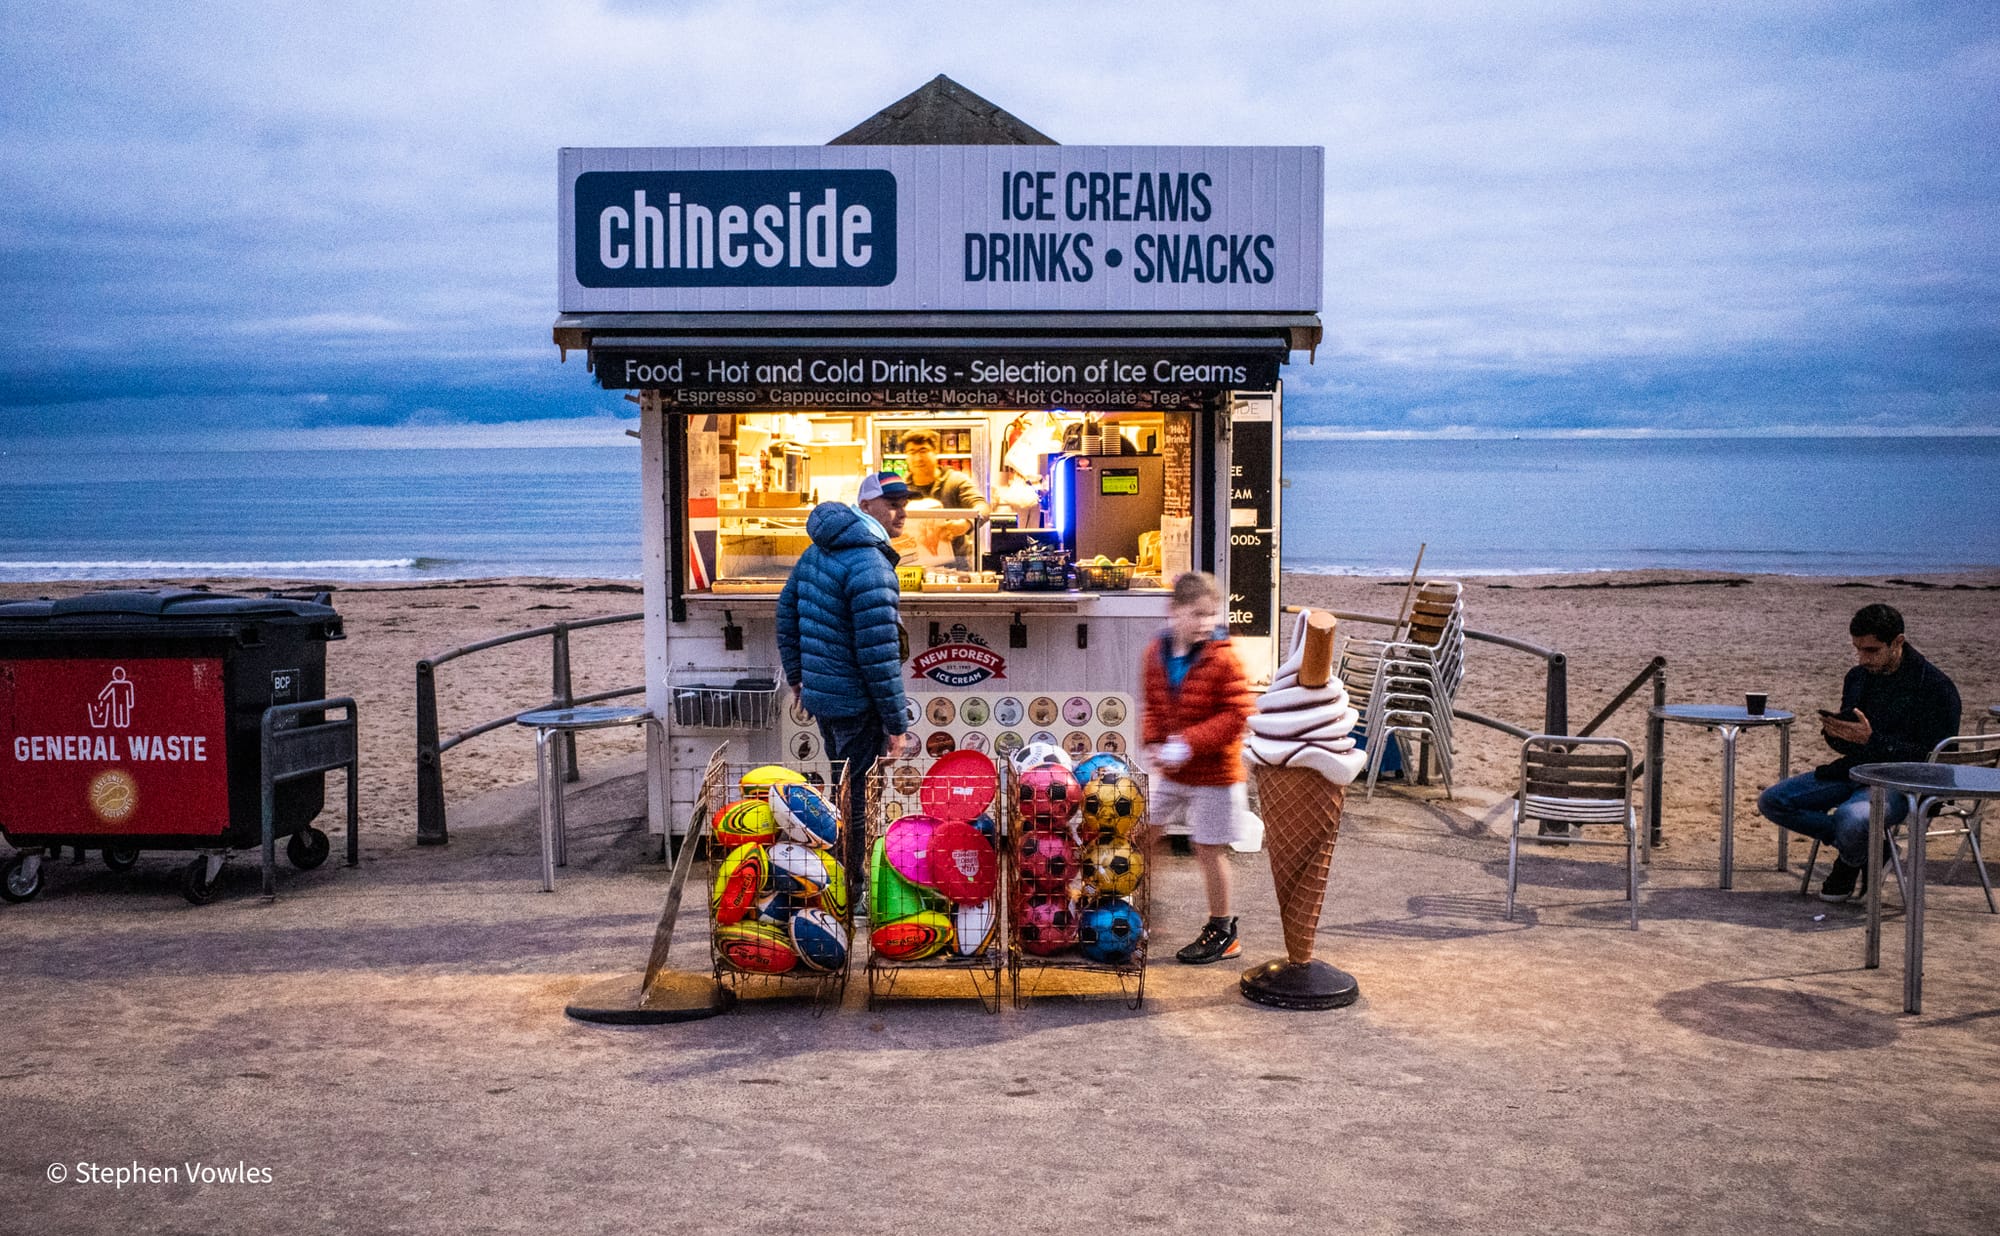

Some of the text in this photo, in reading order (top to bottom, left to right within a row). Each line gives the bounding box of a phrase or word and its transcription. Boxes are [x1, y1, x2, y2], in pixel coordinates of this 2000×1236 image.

[1002, 171, 1213, 222] ICE CREAMS
[600, 188, 872, 269] chineside
[964, 233, 1094, 282] DRINKS
[1133, 233, 1275, 284] SNACKS
[625, 358, 683, 383] Food
[708, 359, 750, 383] Hot
[756, 358, 803, 383] and
[810, 358, 864, 383] Cold
[871, 358, 947, 383] Drinks
[970, 359, 1076, 383] Selection
[1083, 359, 1108, 383] of
[1113, 360, 1147, 384] Ice
[1153, 360, 1247, 384] Creams
[677, 388, 1181, 405] Espresso Cappuccino Latte Mocha Hot Chocolate Tea
[1230, 488, 1253, 500] EAM
[1231, 534, 1261, 546] OODS
[1229, 609, 1254, 624] ate
[919, 648, 999, 668] NEW FOREST
[274, 676, 291, 690] BCP
[935, 671, 982, 684] ICE CREAM
[14, 736, 207, 762] GENERAL WASTE
